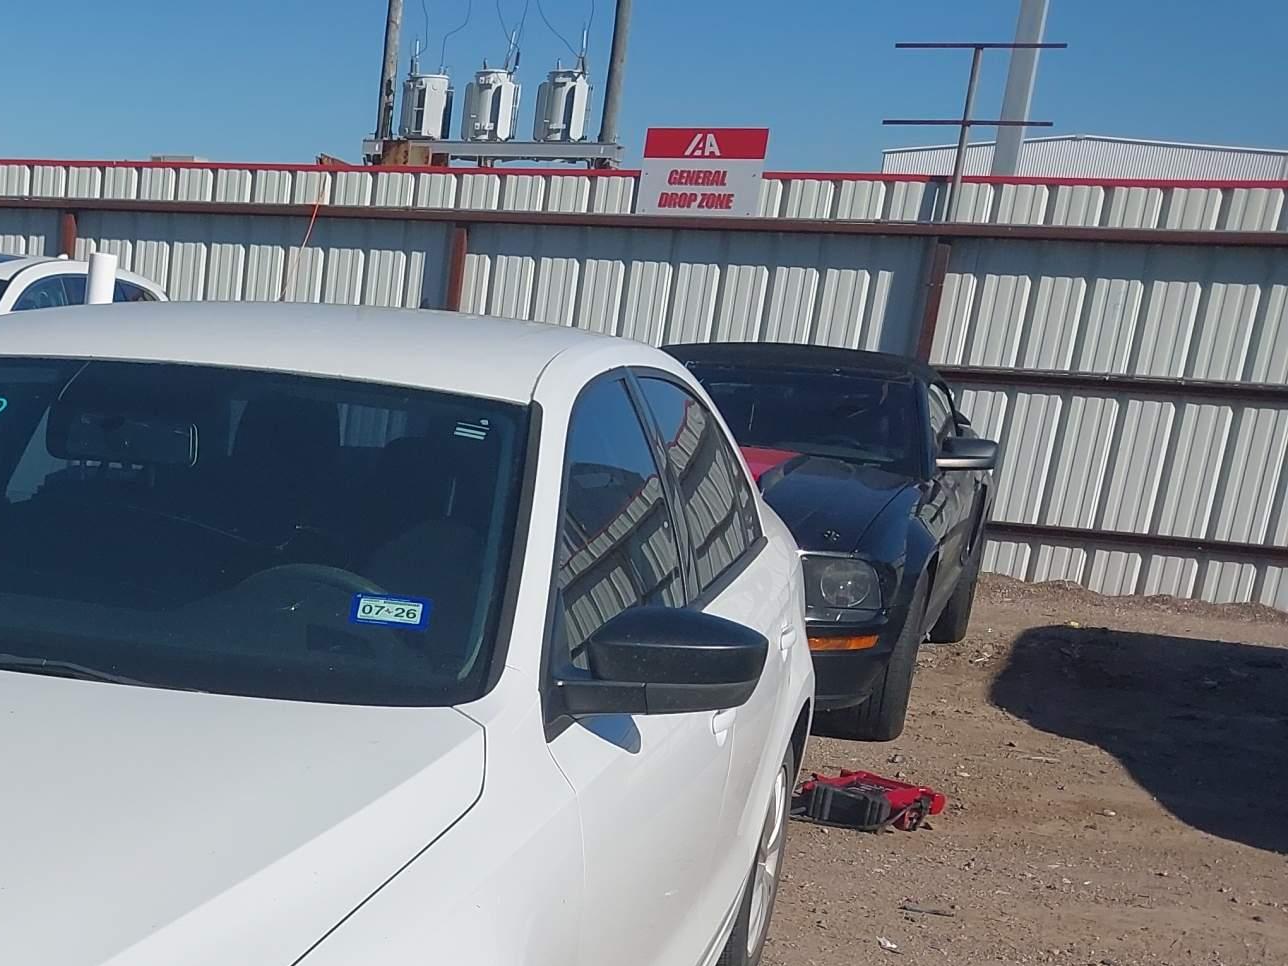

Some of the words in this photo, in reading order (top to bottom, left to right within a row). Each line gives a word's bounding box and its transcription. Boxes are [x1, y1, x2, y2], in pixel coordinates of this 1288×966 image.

[667, 169, 728, 187] GENERAL
[657, 192, 697, 209] DROP
[697, 193, 735, 210] ZONE
